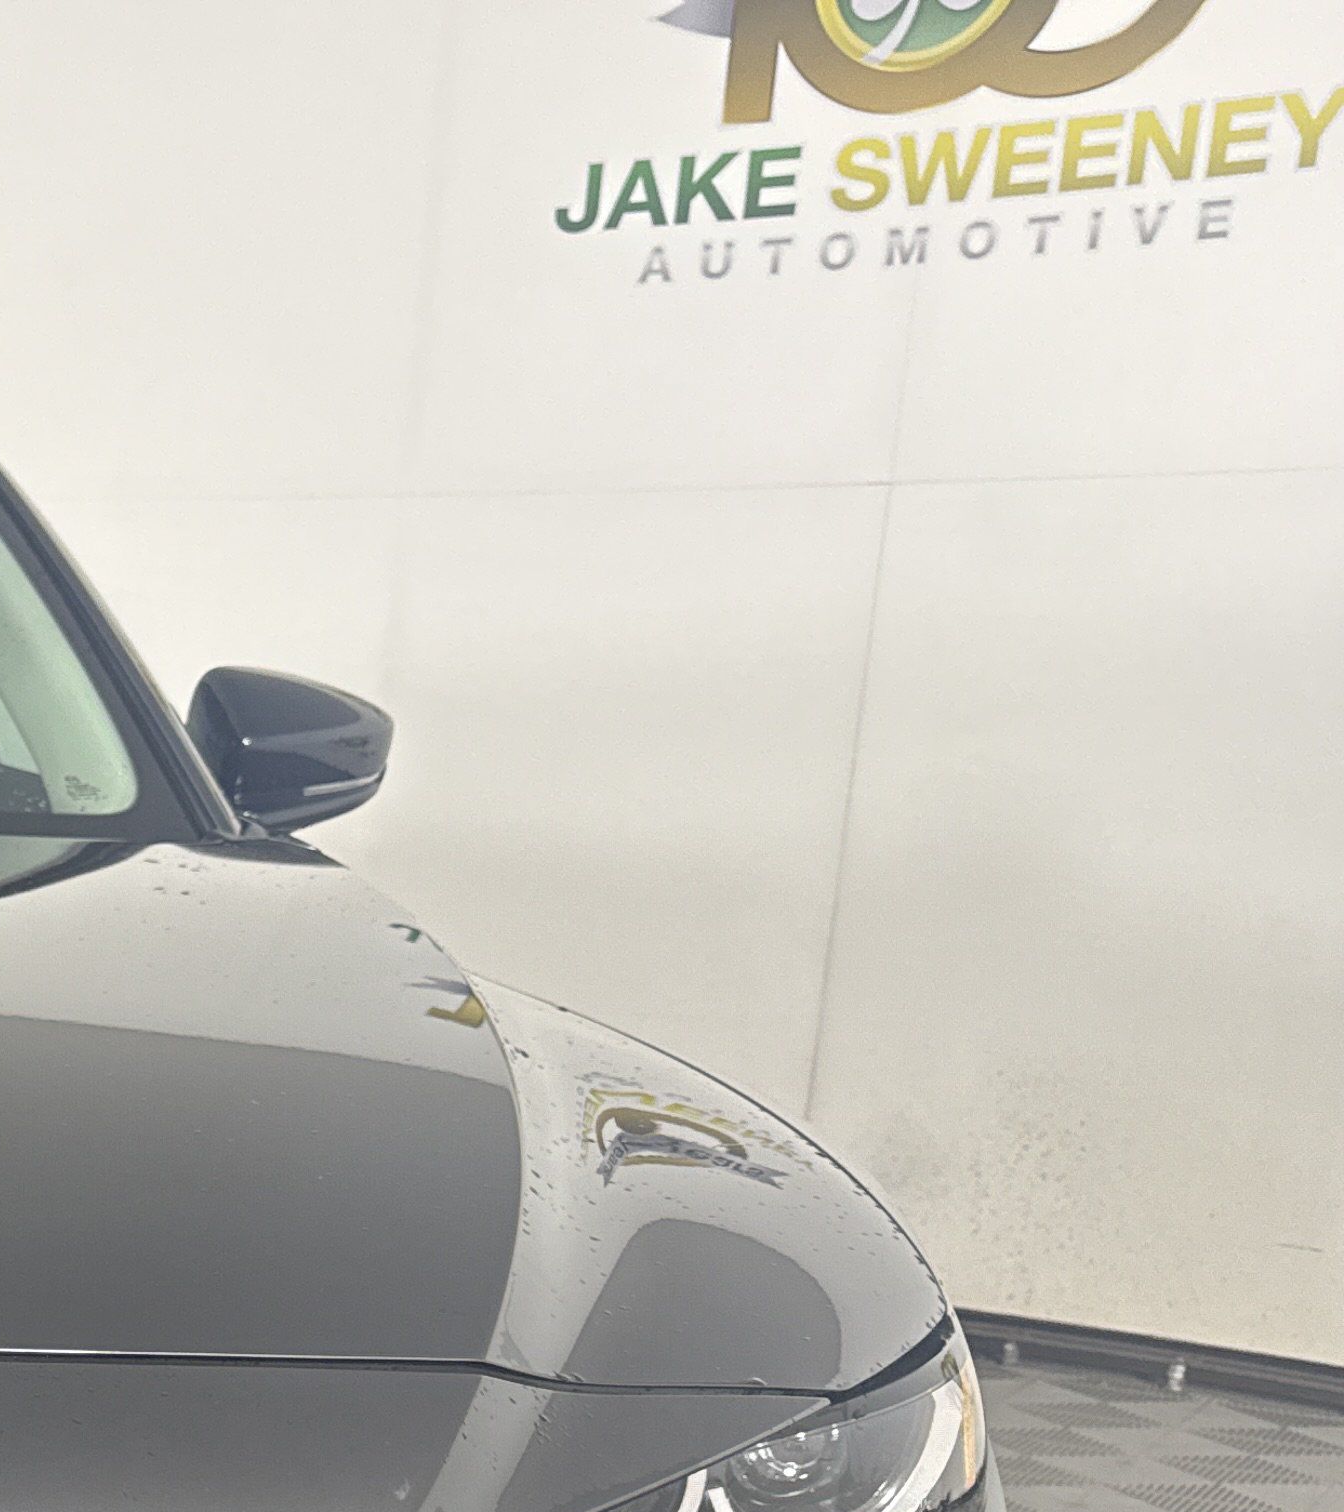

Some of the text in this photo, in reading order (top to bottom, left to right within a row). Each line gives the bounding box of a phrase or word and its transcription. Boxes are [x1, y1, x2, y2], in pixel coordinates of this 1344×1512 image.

[554, 87, 1344, 234] JAKE SWEENEY
[638, 199, 1236, 285] AUTOMOTIVE
